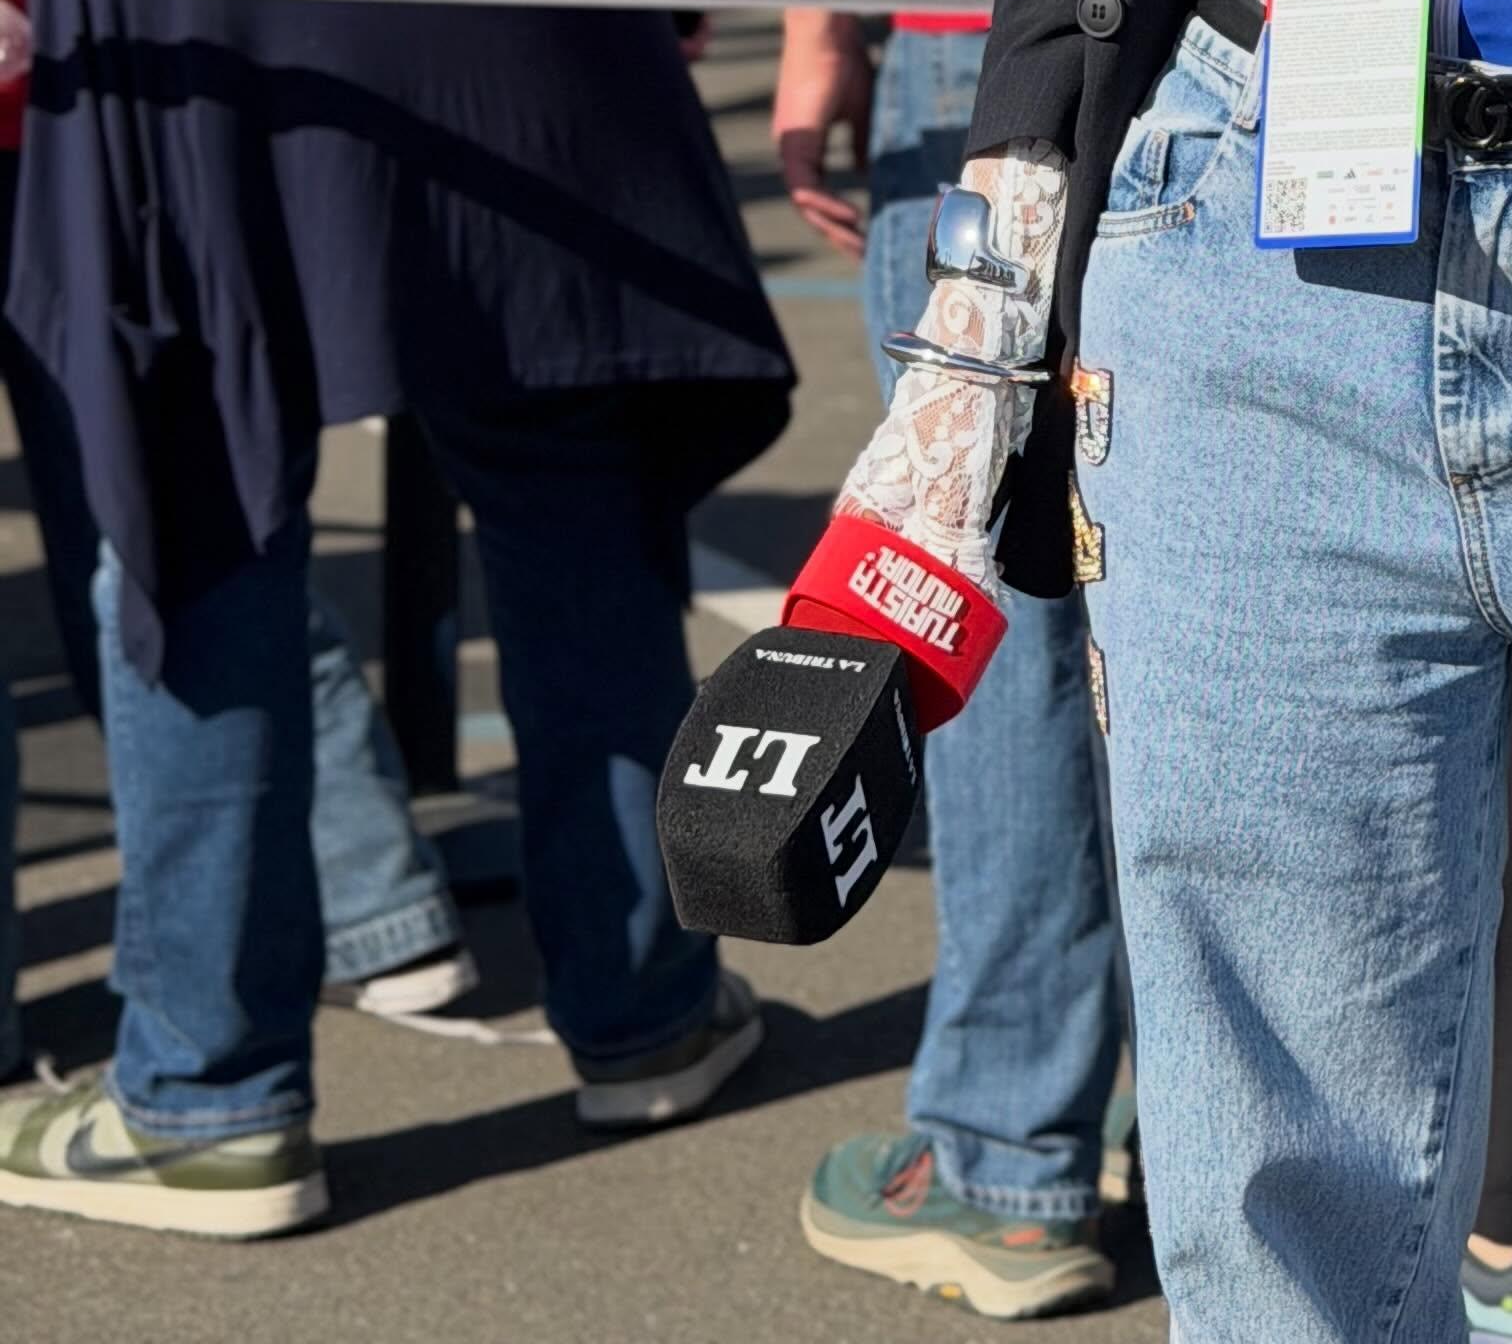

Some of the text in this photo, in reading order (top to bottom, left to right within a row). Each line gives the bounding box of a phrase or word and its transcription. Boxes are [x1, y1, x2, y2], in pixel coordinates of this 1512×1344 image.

[848, 559, 960, 653] TURISTA
[875, 545, 965, 619] MUNDIAL
[754, 649, 867, 673] LA TRIBUNA
[683, 724, 821, 796] LT
[820, 773, 879, 907] LT
